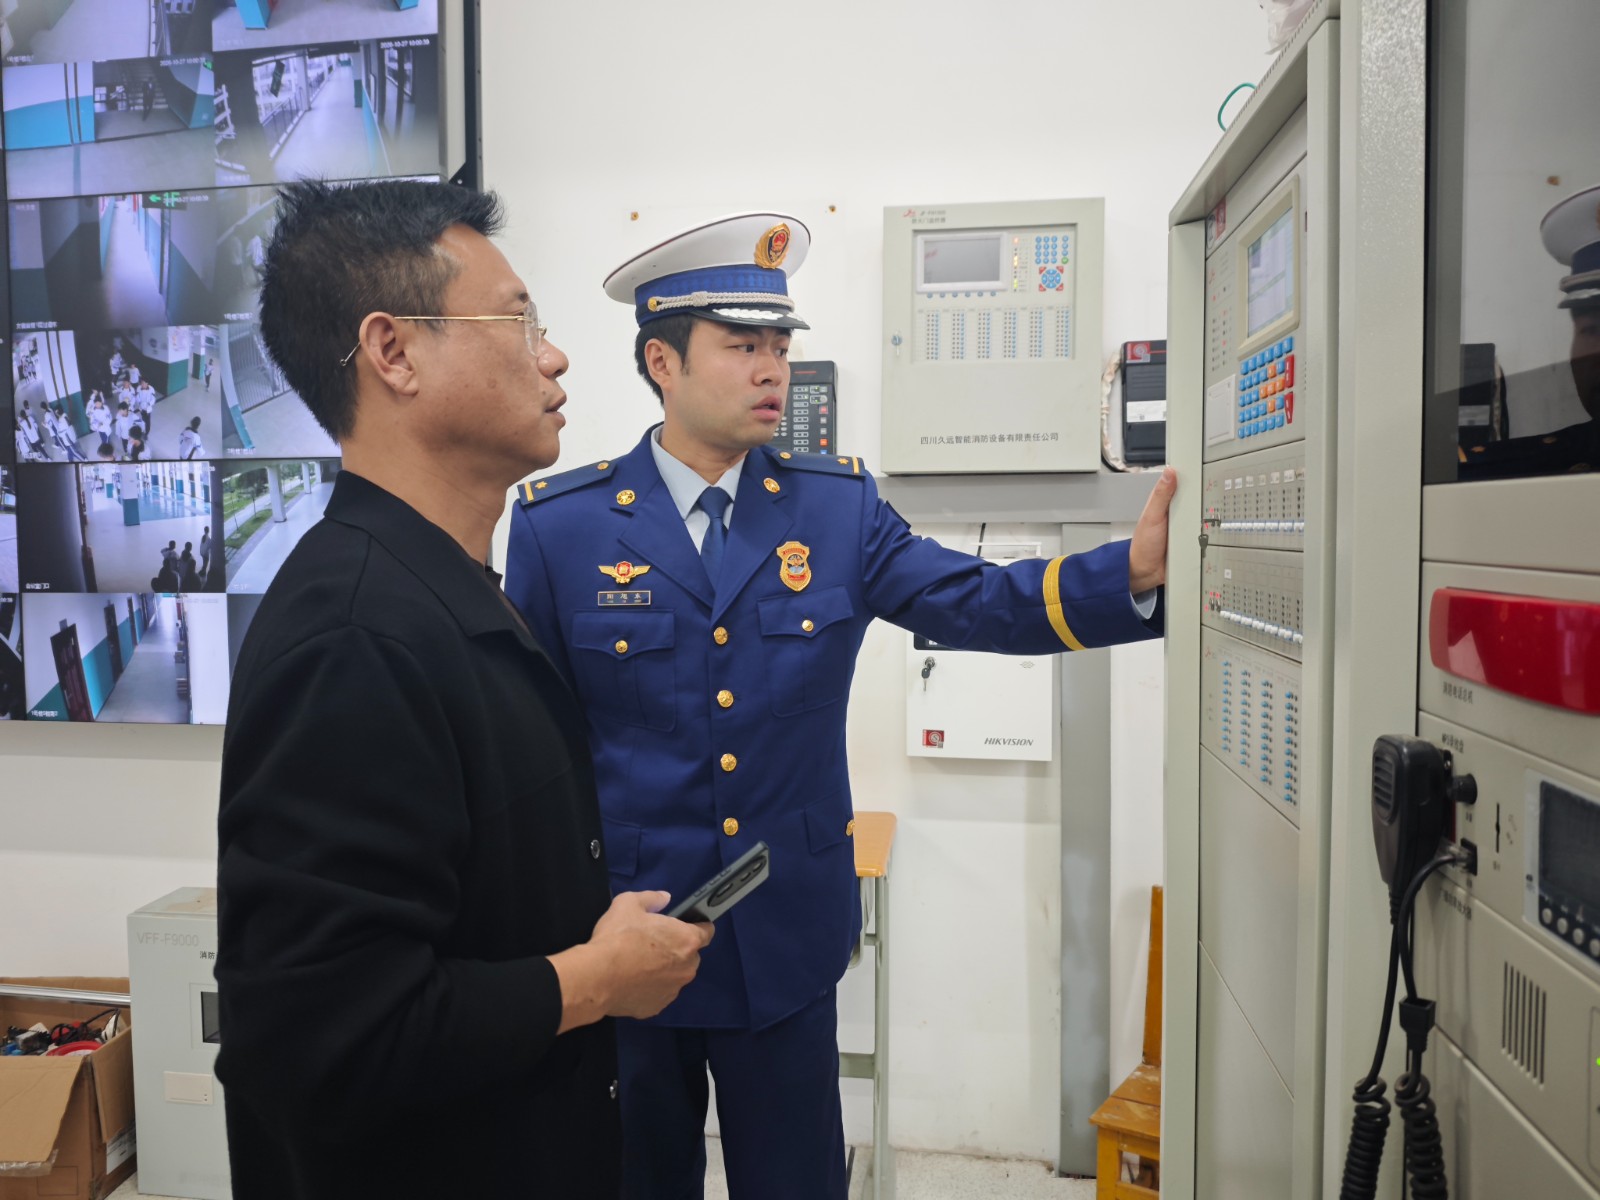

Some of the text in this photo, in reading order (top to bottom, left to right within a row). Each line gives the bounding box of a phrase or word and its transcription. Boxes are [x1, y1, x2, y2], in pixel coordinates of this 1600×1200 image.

[920, 432, 1060, 446] 四川久远智能消防设备有限责任公司
[984, 737, 1034, 747] HIKVISION
[136, 931, 200, 947] VFF-F9000
